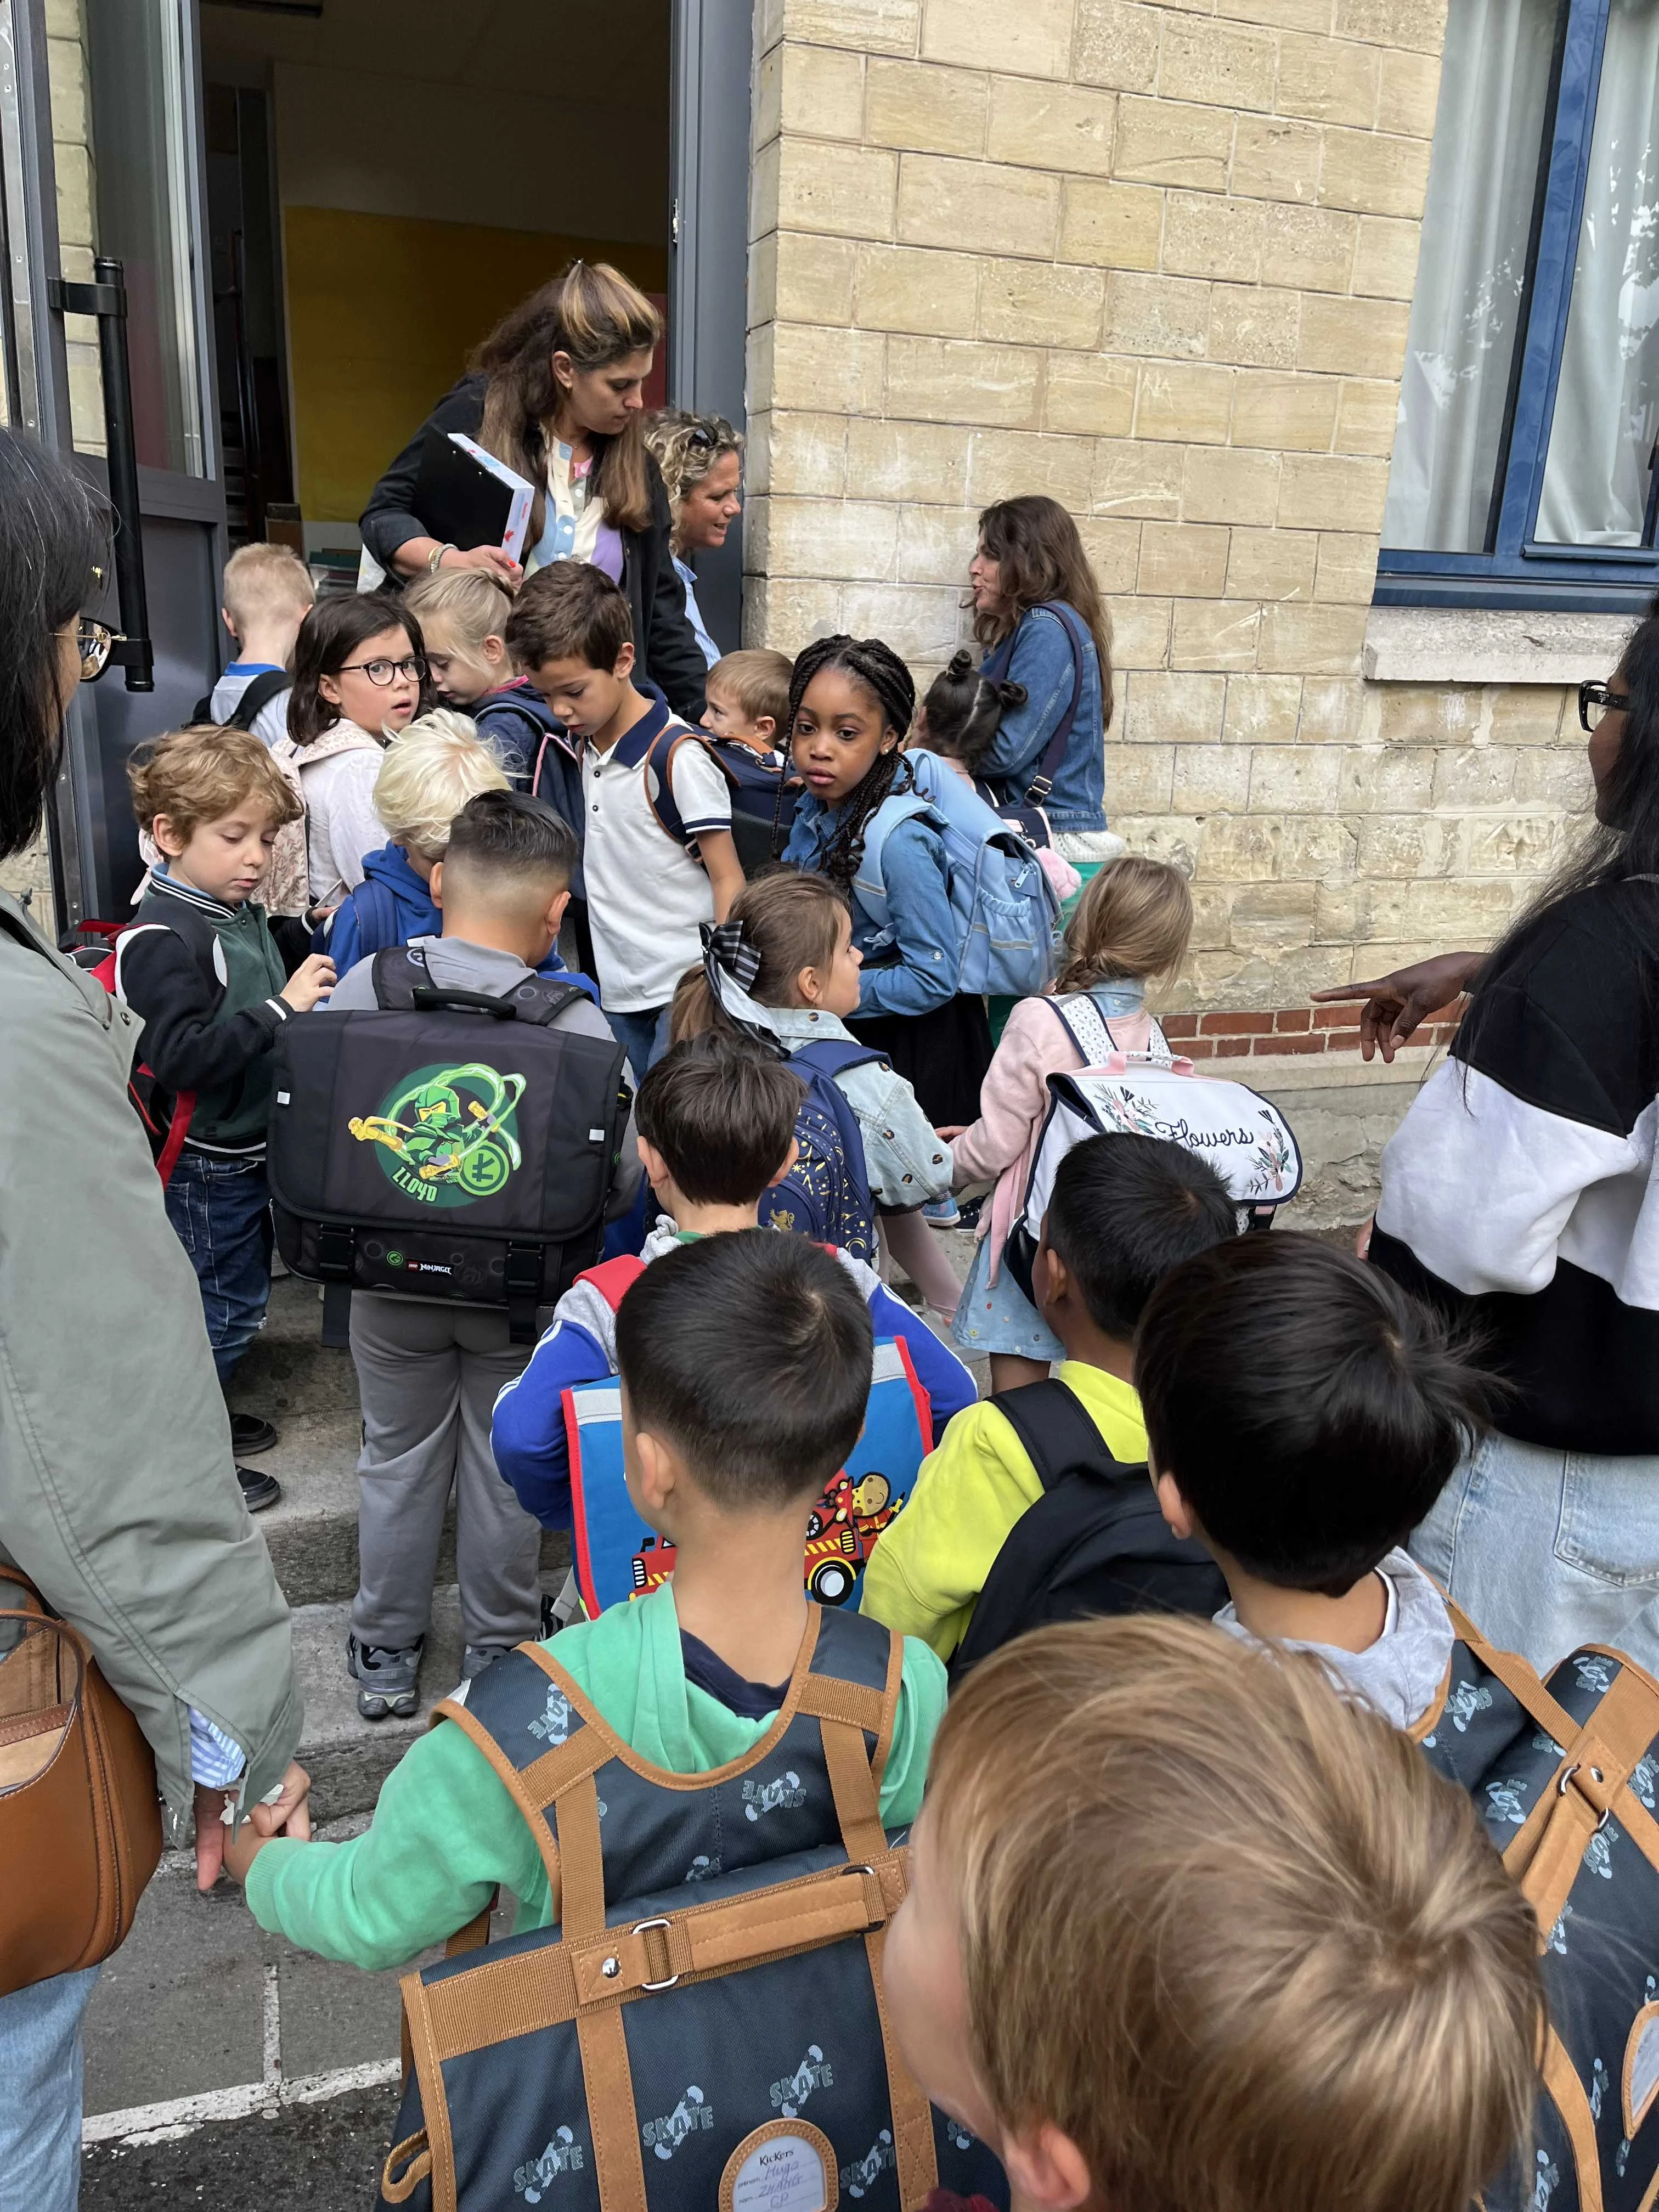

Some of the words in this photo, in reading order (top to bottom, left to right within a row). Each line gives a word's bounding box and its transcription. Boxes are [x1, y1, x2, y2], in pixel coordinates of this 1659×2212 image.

[1155, 1118, 1254, 1148] Flowers
[392, 1166, 438, 1201] LLOYD
[741, 1780, 806, 1808] SKATE
[769, 2063, 833, 2107] SKATE
[642, 2105, 714, 2146] SKATE
[513, 2146, 584, 2192] SKATE
